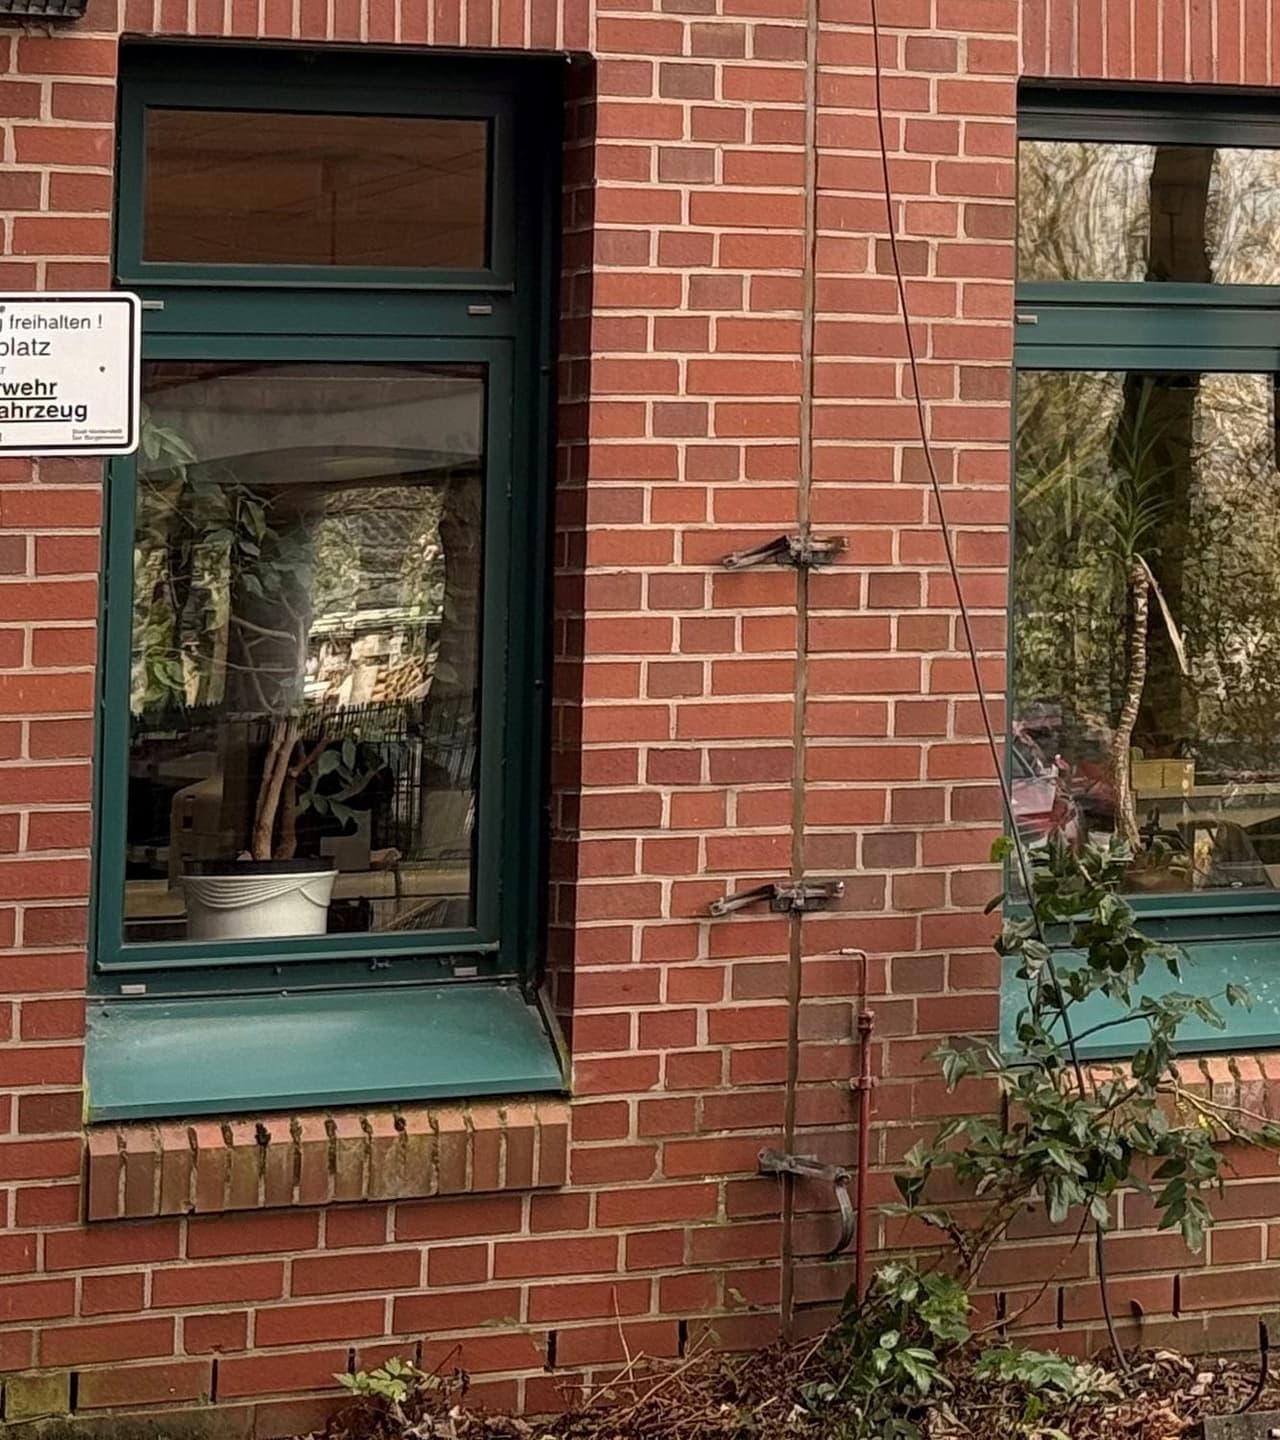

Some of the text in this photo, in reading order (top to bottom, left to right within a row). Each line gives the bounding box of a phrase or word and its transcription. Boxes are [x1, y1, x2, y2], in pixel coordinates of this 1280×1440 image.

[9, 314, 91, 329] freihalten
[98, 314, 103, 329] !
[0, 378, 57, 396] wehr
